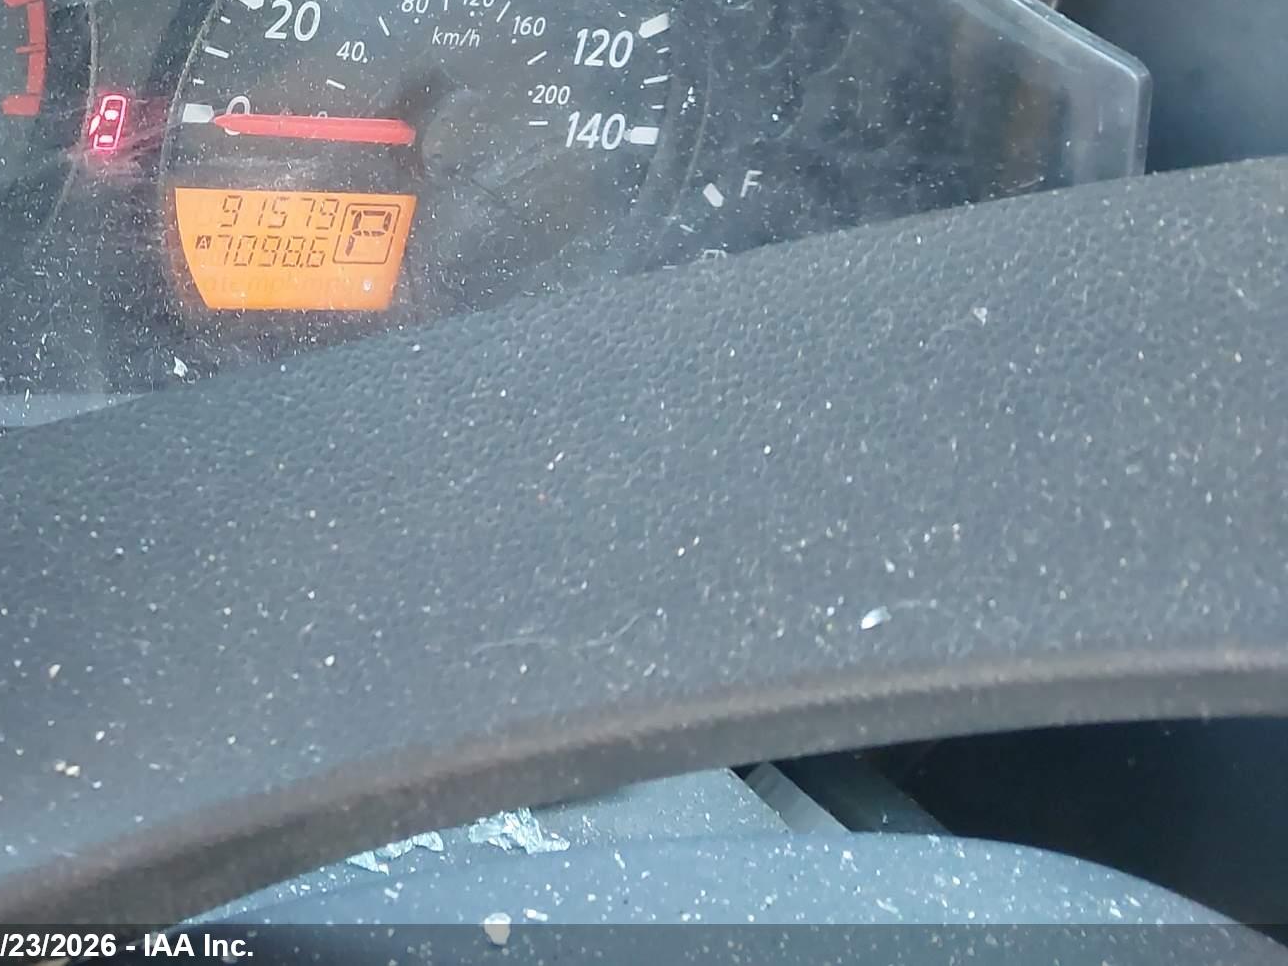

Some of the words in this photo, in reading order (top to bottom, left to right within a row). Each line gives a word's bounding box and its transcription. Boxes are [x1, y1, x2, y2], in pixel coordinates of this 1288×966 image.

[265, 0, 320, 41] 20
[431, 26, 481, 47] km/h
[512, 16, 546, 36] 160
[337, 41, 365, 61] 40
[573, 28, 634, 68] 120
[532, 84, 570, 105] 200
[565, 110, 625, 151] 140
[740, 169, 763, 198] F
[219, 194, 340, 230] 91579
[344, 208, 394, 258] P
